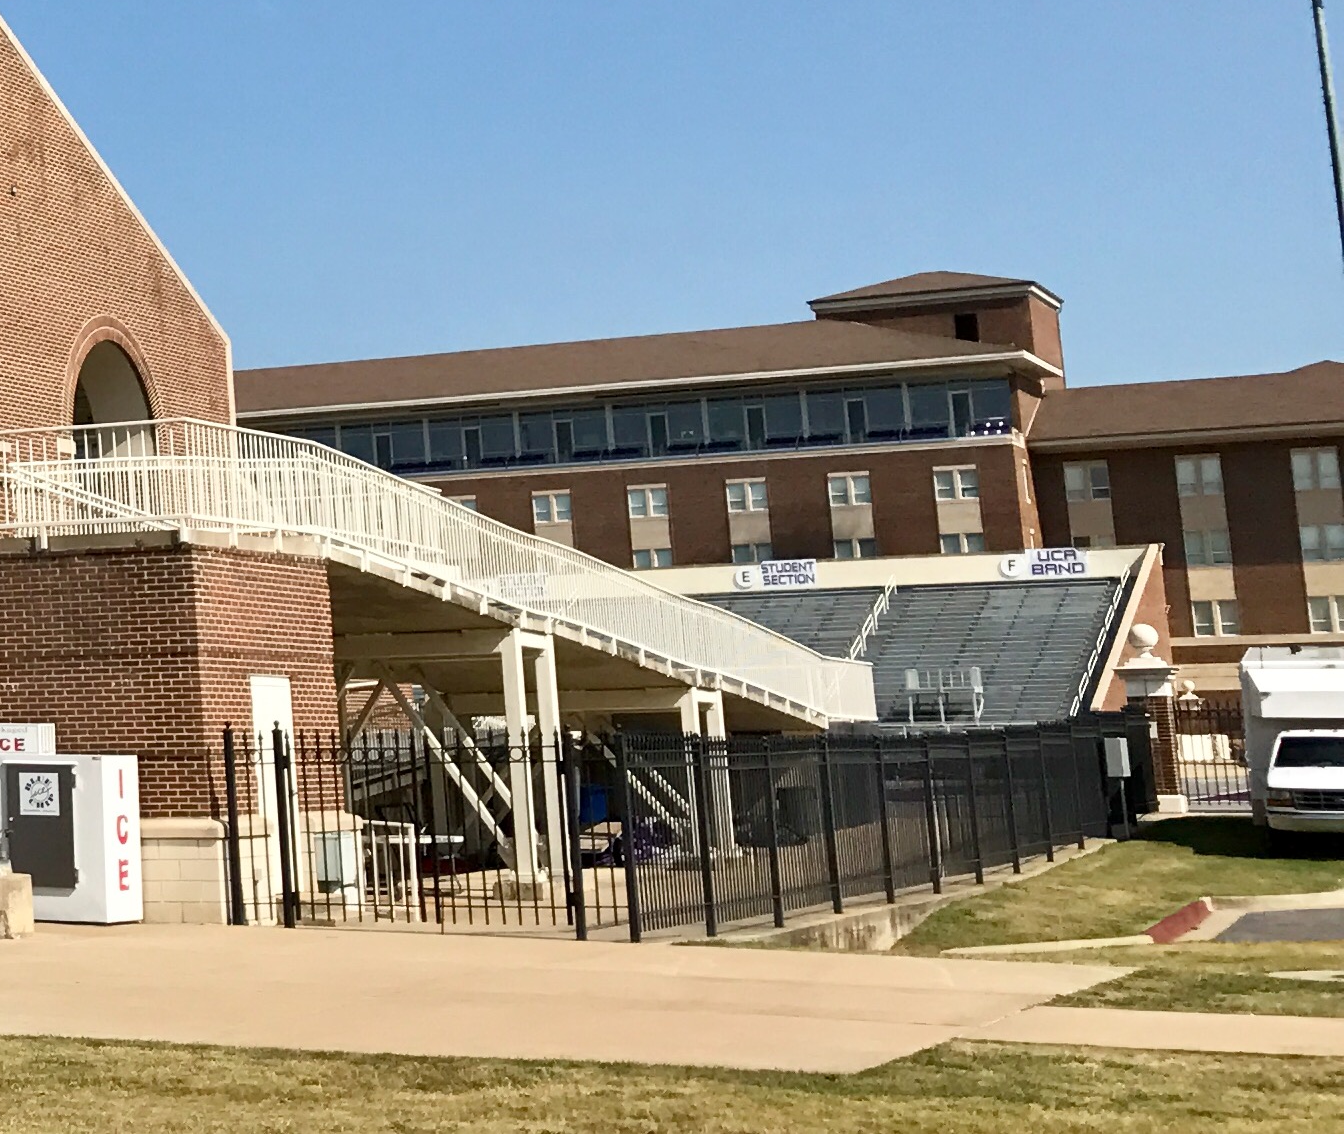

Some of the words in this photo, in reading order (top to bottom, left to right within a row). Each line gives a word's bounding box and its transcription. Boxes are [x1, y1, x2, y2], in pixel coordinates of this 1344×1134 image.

[1037, 549, 1077, 562] UCA
[760, 561, 814, 574] STUDENT
[1008, 559, 1016, 572] F
[1031, 562, 1085, 575] BAND
[741, 570, 751, 583] E
[762, 573, 815, 586] SECTION
[115, 768, 130, 892] ICE
